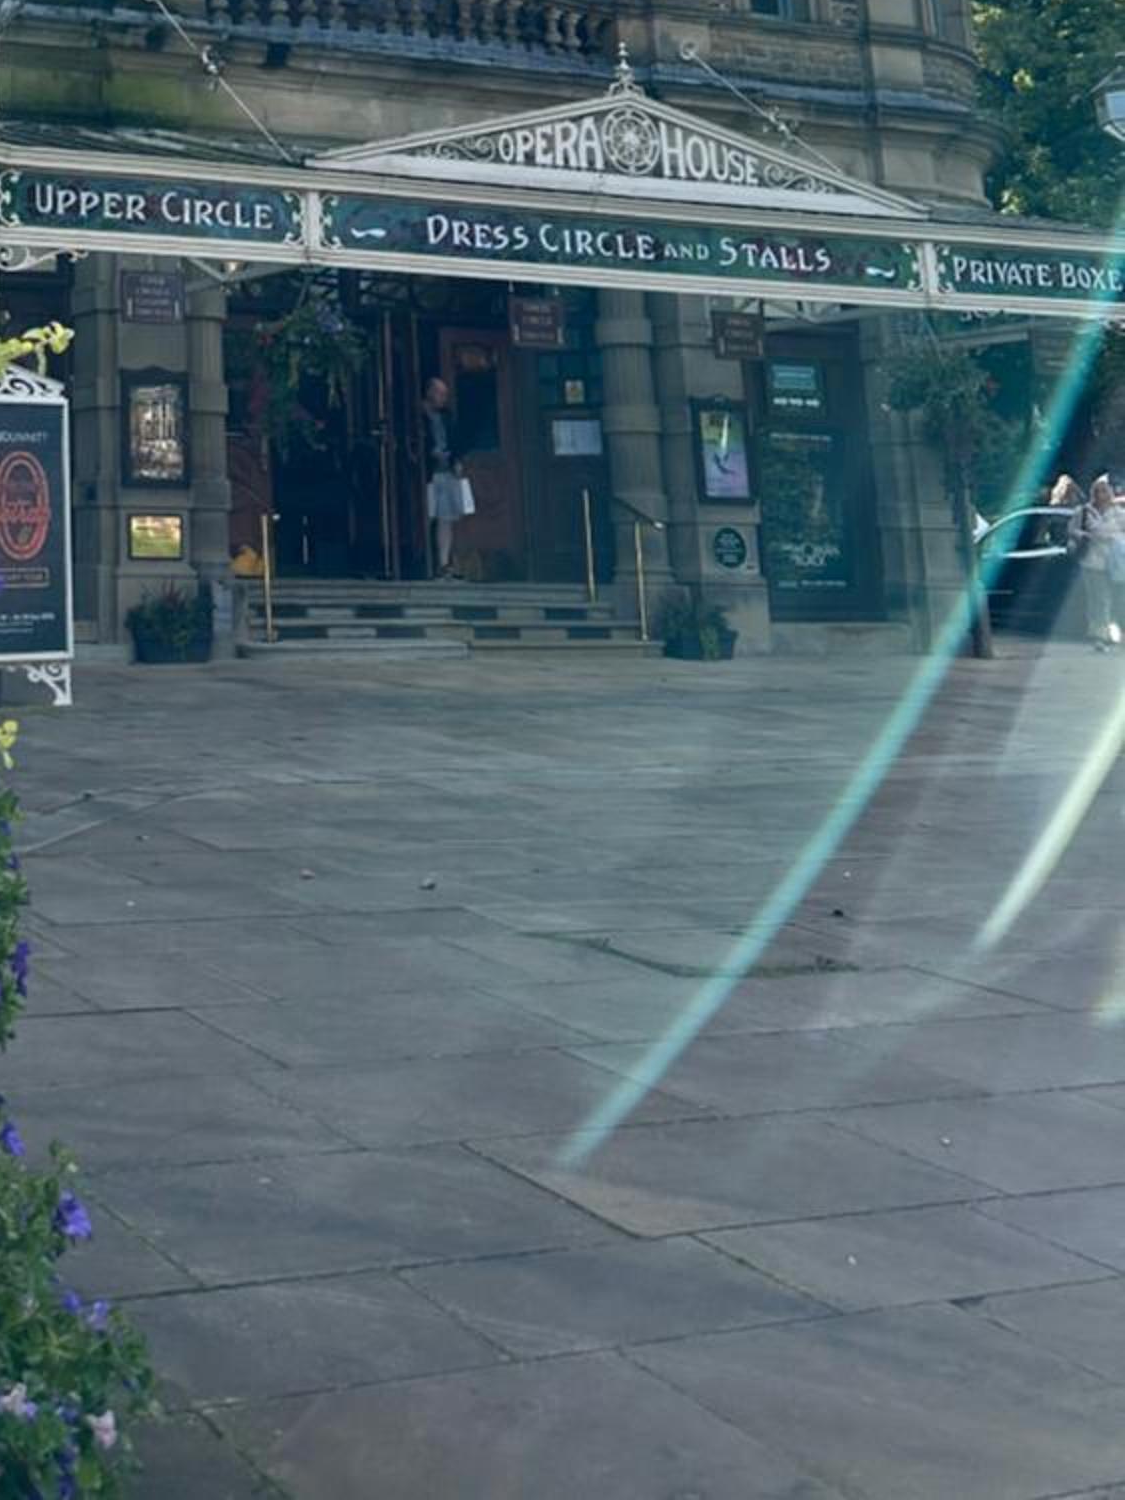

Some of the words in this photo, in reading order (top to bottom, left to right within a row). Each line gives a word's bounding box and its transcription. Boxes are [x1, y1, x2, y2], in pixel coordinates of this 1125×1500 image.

[497, 117, 605, 171] OPERA
[660, 121, 759, 186] HOUSE
[33, 182, 147, 222] UPPER
[159, 190, 275, 230] CIRCLE
[426, 214, 530, 252] DRESS
[537, 222, 656, 262] CIRCLE
[663, 243, 710, 262] AND
[718, 236, 833, 273] STALLS
[953, 256, 1053, 287] PRIVATE
